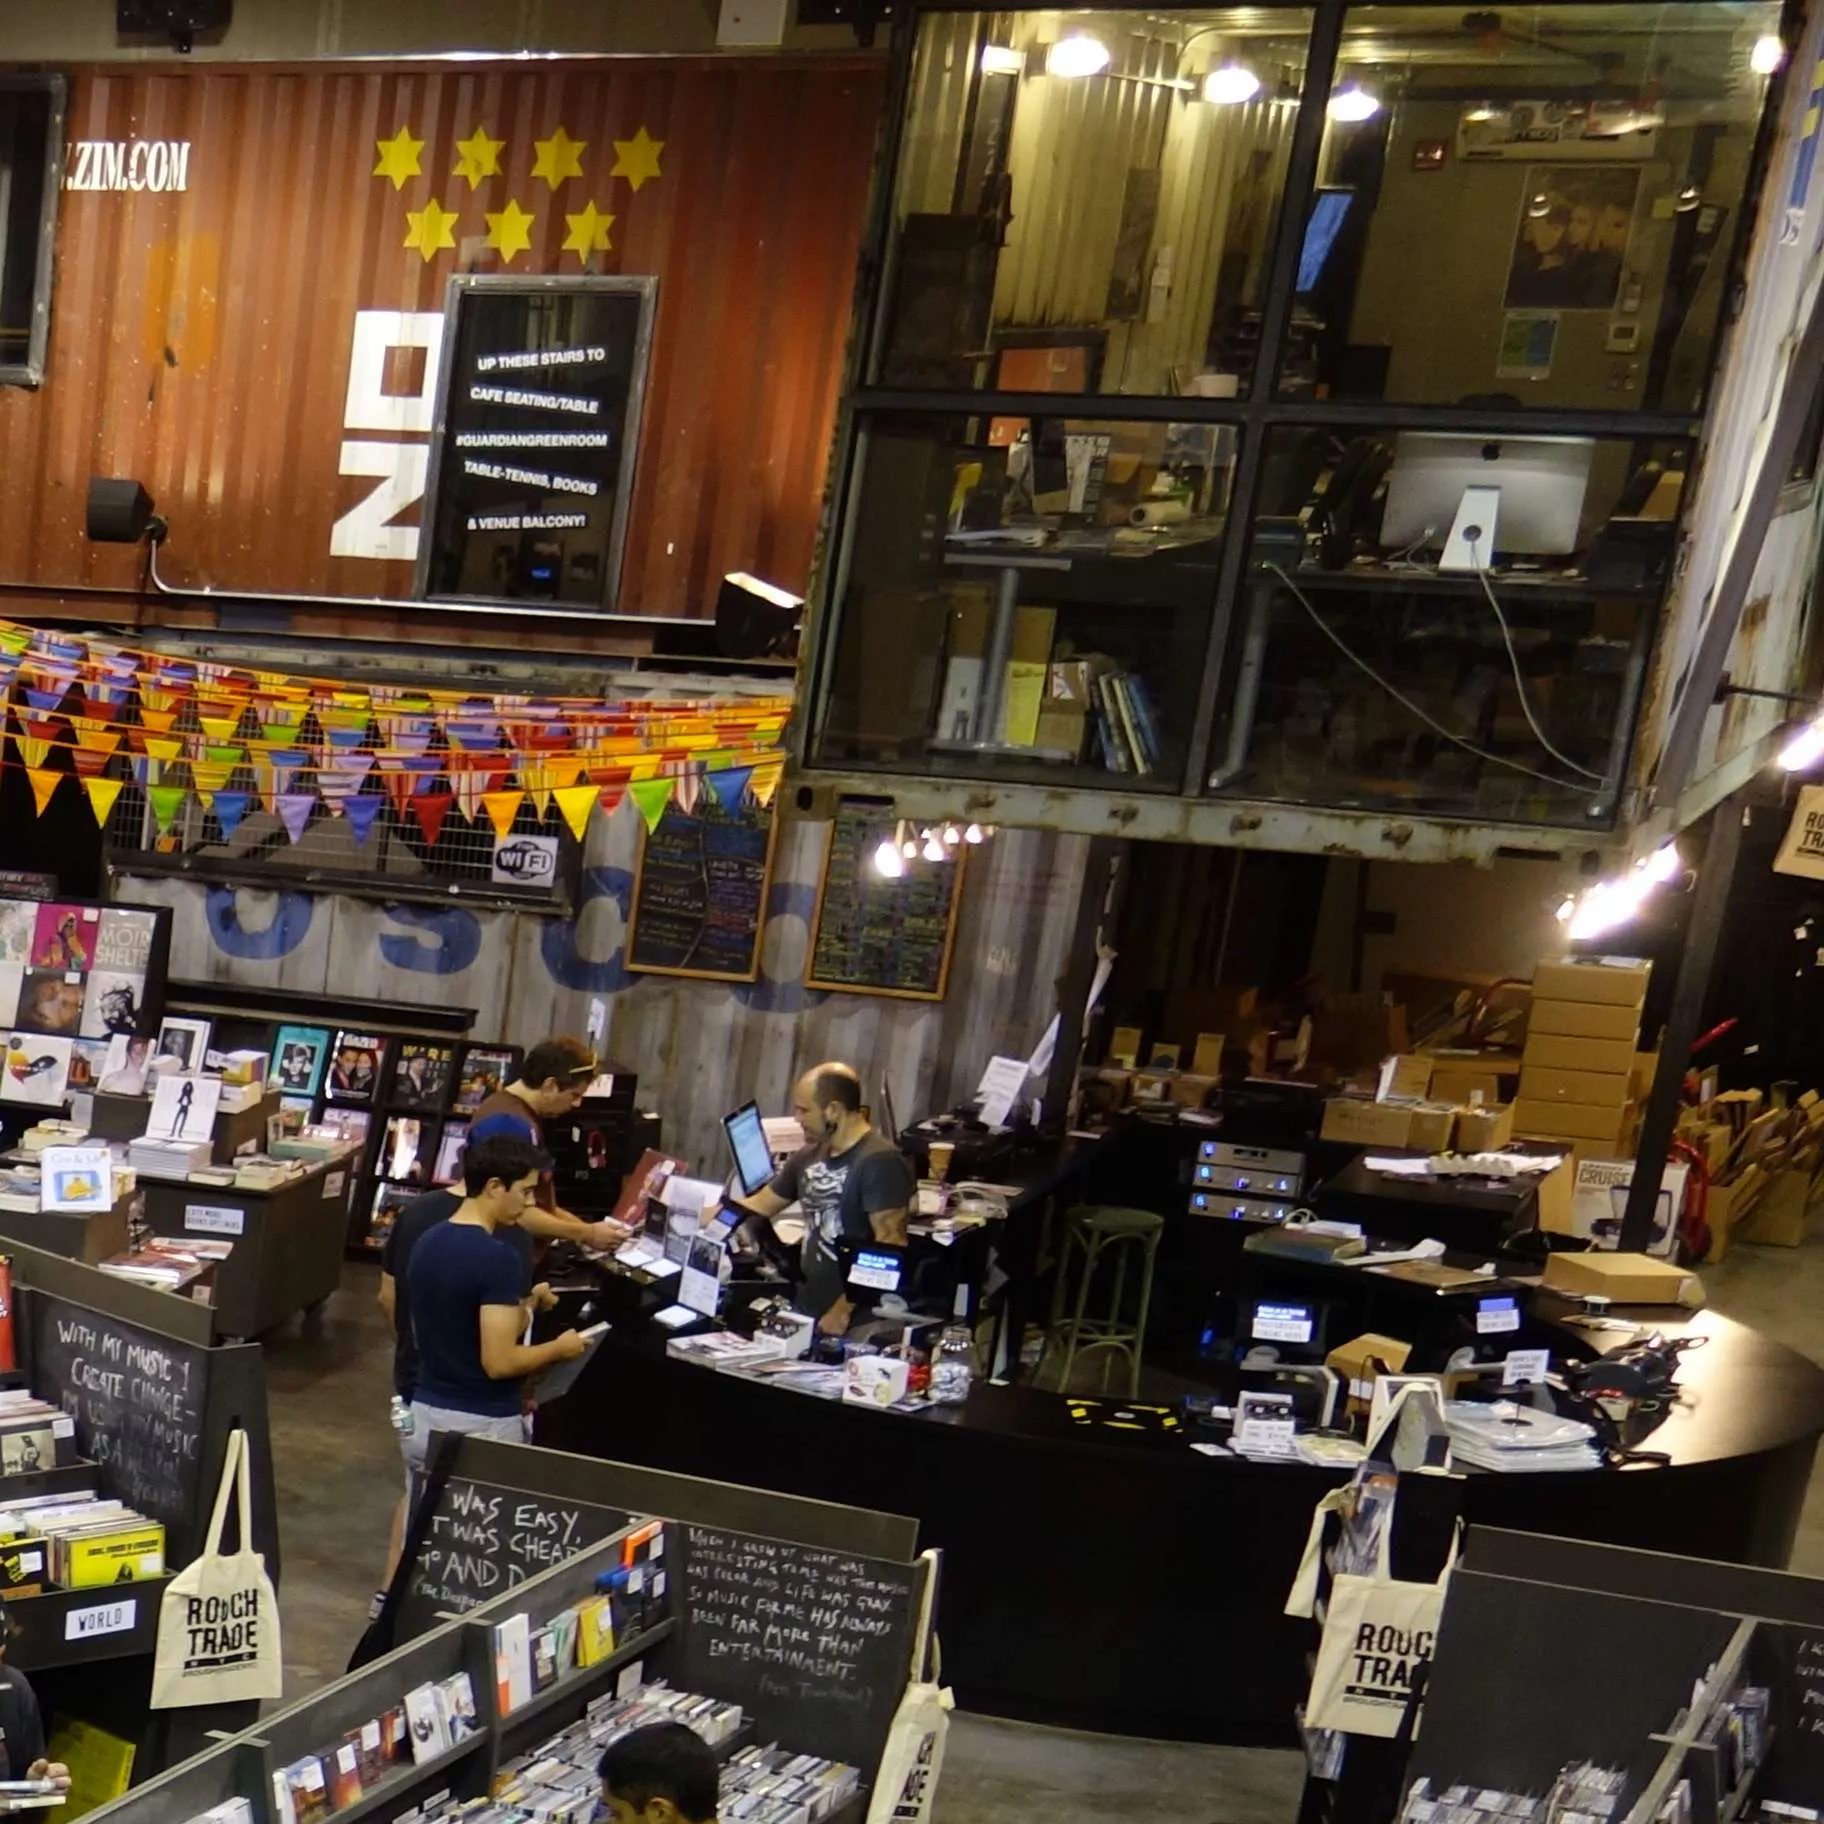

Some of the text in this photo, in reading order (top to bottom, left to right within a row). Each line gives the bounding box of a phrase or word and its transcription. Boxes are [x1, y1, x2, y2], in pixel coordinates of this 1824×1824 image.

[477, 348, 605, 371] UP THESE STAIRS TO
[470, 387, 599, 414] CAFE SEATING/TABLE
[456, 434, 608, 447] #GUARDIANGREENROOM
[464, 461, 597, 495] TABLE-TENNIS, BOOKS
[479, 515, 586, 529] VENUE BALCONY!
[452, 1485, 503, 1525] WAS
[452, 1522, 500, 1554] WAS
[442, 1552, 499, 1587] AND
[78, 1607, 123, 1632] WORLD
[187, 1590, 259, 1626] ROUGH
[187, 1624, 258, 1657] TRADE
